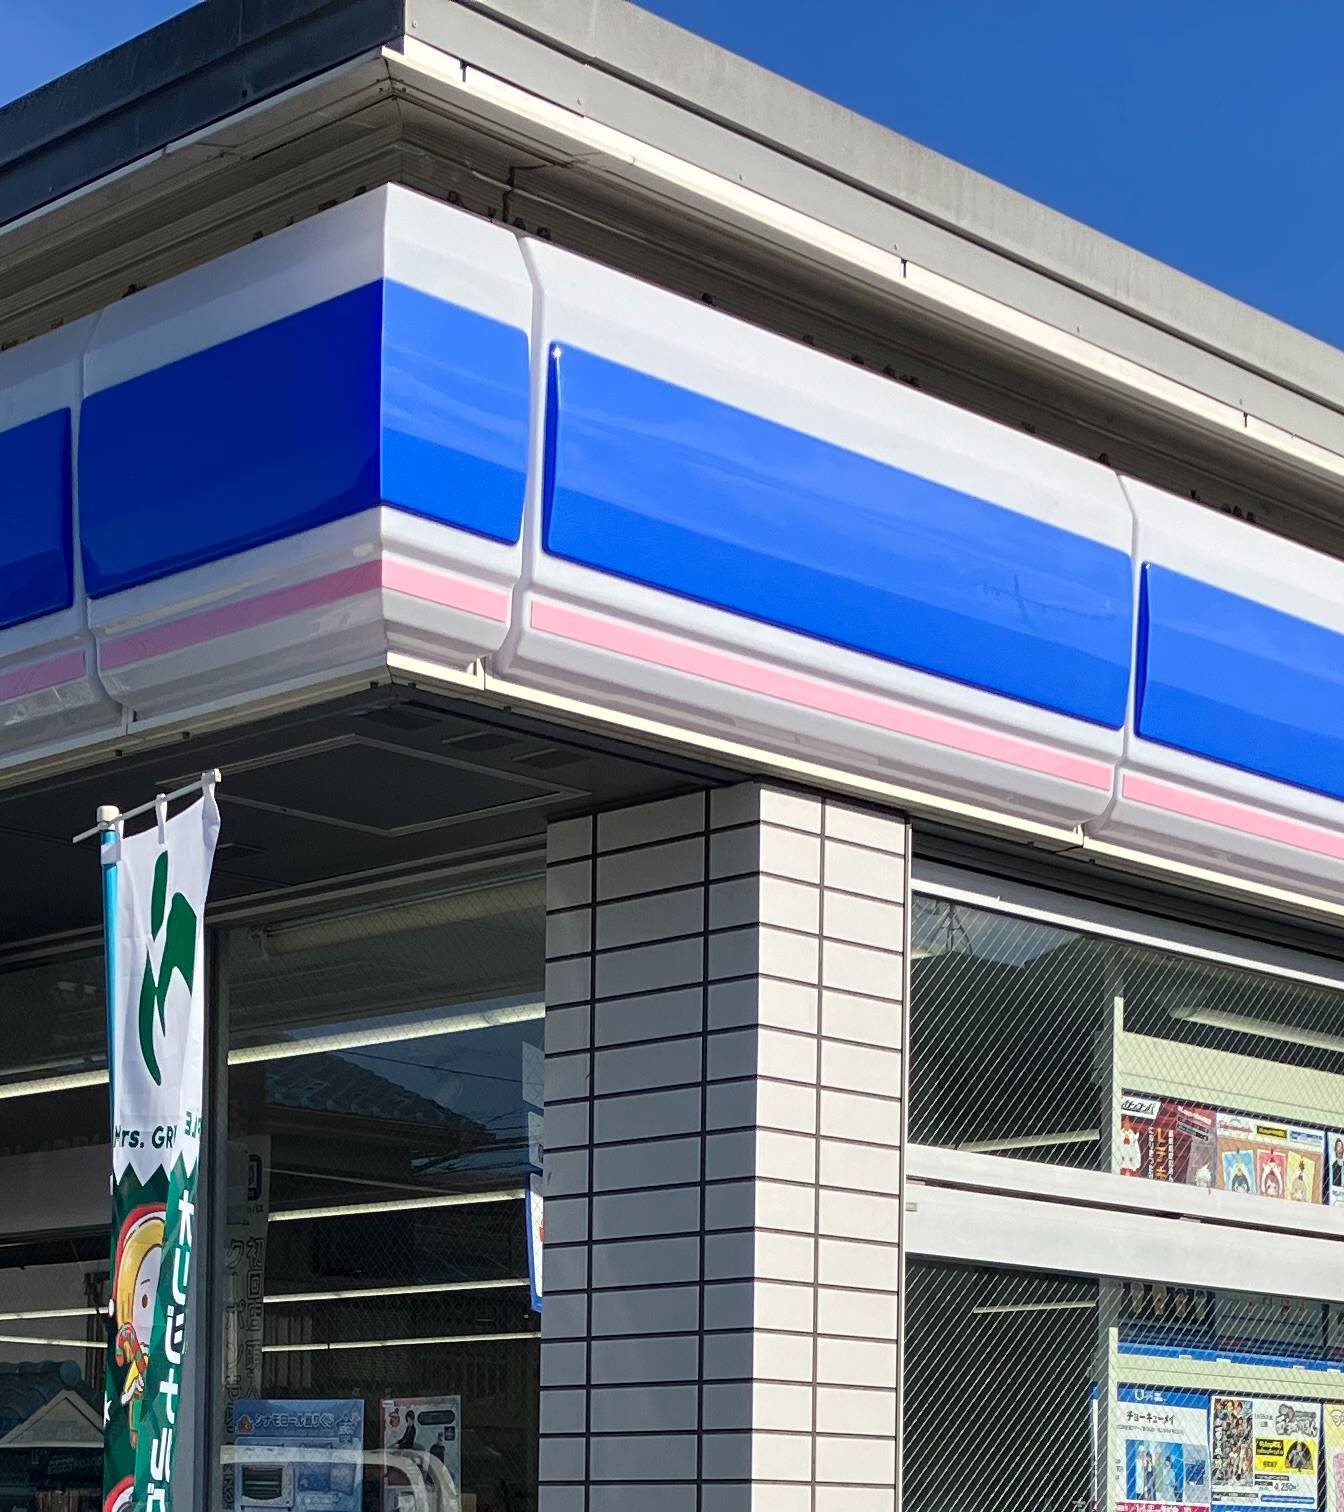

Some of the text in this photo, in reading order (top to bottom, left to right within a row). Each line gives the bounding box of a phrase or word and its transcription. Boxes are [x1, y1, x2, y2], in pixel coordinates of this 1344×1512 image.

[1126, 1410, 1175, 1425] チョーキューメイ
